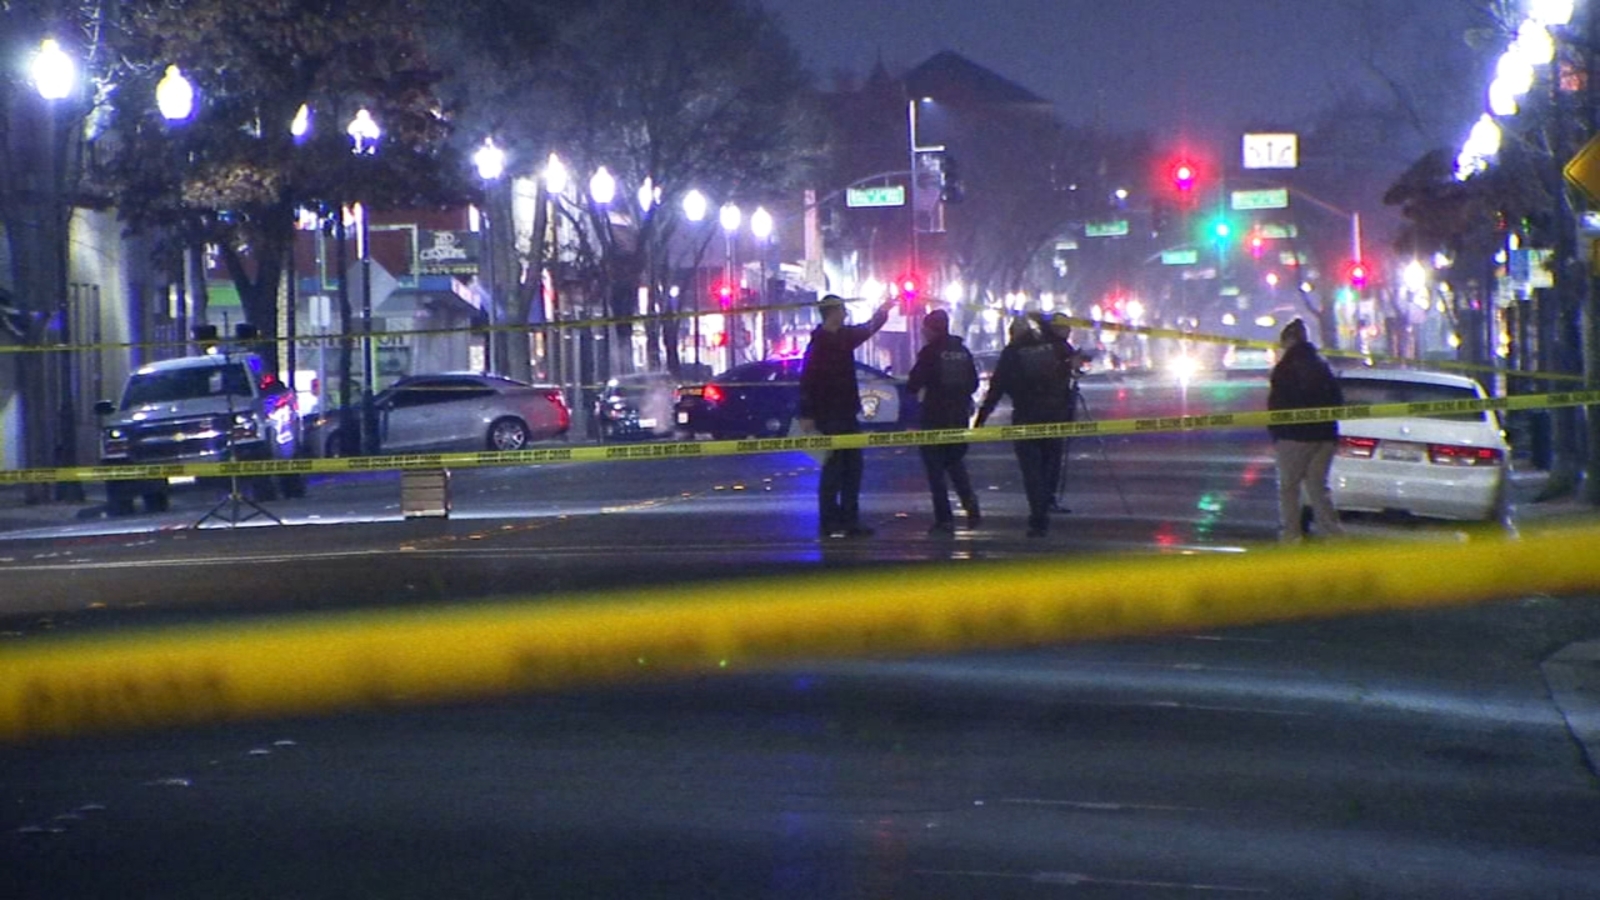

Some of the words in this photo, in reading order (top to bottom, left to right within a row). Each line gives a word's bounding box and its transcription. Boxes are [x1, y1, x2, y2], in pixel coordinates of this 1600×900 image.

[1060, 424, 1073, 434] NOT
[1075, 422, 1098, 433] CROSS
[738, 441, 759, 452] CRIME
[761, 440, 782, 451] SCENE
[784, 439, 793, 450] DO
[795, 438, 808, 449] NOT
[810, 437, 832, 449] CROSS
[869, 433, 891, 445] CRIME
[893, 432, 914, 444] SCENE
[916, 432, 926, 443] DO
[928, 431, 940, 442] NOT
[549, 449, 571, 460] CROSS
[607, 447, 628, 458] CRIME
[630, 446, 651, 457] SCENE
[653, 445, 662, 456] DO
[664, 444, 677, 455] NOT
[679, 444, 700, 454] CROSS
